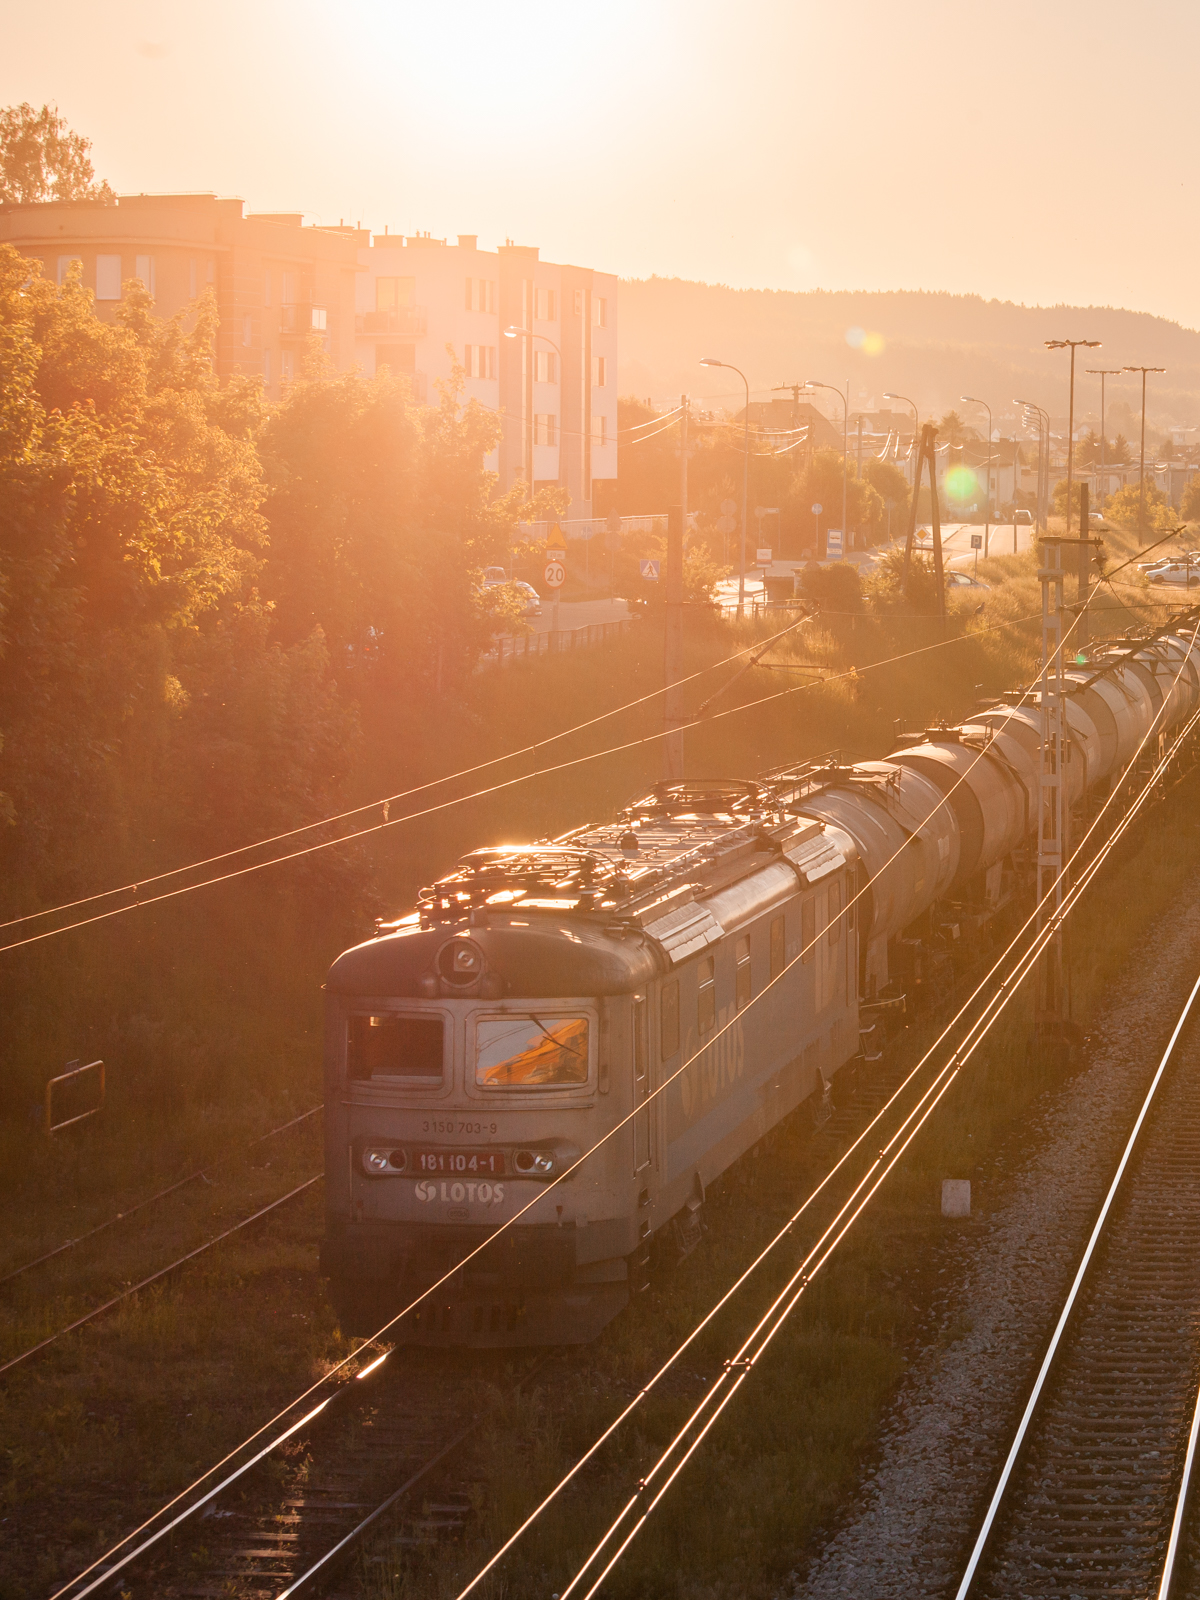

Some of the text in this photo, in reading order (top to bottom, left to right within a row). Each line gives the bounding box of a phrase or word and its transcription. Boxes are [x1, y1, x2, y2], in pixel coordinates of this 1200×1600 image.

[973, 536, 980, 547] P
[547, 567, 564, 582] 20
[458, 1122, 497, 1134] 703-9
[449, 1154, 495, 1172] 104-1
[440, 1182, 505, 1203] LOTOS
